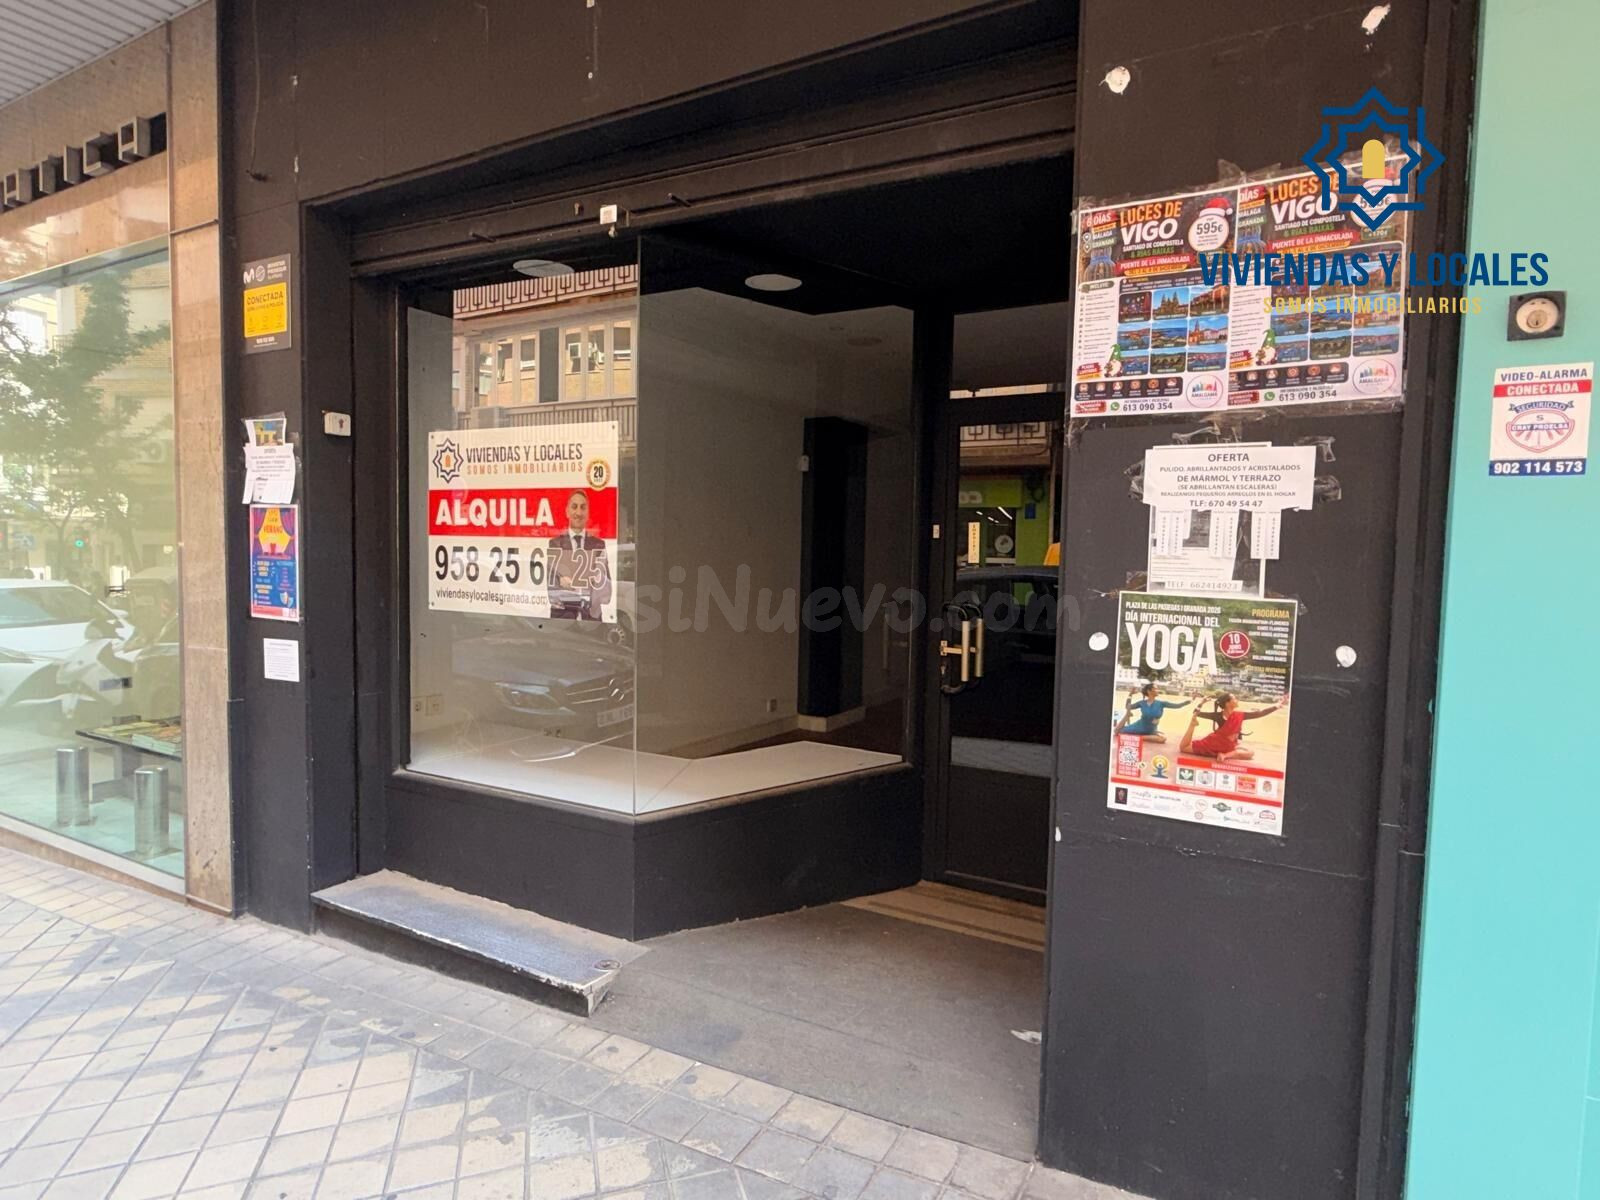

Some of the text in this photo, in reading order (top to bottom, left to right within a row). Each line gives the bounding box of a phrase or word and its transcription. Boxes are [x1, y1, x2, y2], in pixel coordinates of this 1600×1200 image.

[2, 113, 152, 208] ATICA
[1269, 177, 1319, 204] LUCES
[1120, 201, 1182, 226] LUCES DE
[1271, 192, 1338, 224] VIGO
[1196, 221, 1223, 235] 595€
[1275, 221, 1300, 231] SANTIAGO
[1309, 214, 1346, 226] COMPOSTELA
[1120, 218, 1178, 246] VIGO
[1122, 243, 1145, 252] SANTIAGO
[1153, 239, 1184, 247] COMPOSTELA
[1272, 239, 1295, 249] PUENTE
[1314, 232, 1353, 243] INMACULADA
[1120, 261, 1140, 269] PUENTE
[1157, 256, 1190, 266] INMACULADA
[247, 291, 284, 305] CONECTADA
[1500, 368, 1588, 382] VIDEO-ALARMA
[1279, 389, 1337, 402] 613 090 354
[1507, 383, 1580, 396] CONECTADA
[1123, 401, 1173, 412] 613 090 354
[1516, 401, 1566, 411] SEGURIDAD
[466, 443, 583, 463] VIVIENDAS Y LOCALES
[1207, 453, 1250, 462] OFERTA
[466, 461, 583, 475] SOMOS INMOBILIARIOS
[594, 466, 604, 479] 20
[1494, 461, 1583, 474] 902 114 573
[435, 498, 555, 528] ALQUILA
[435, 545, 608, 590] 958 25 67 25
[435, 588, 549, 606] viviendasylocalesgranada.com
[1125, 610, 1138, 621] DÍA
[1140, 612, 1202, 626] INTERNACIONAL
[1204, 616, 1220, 627] DEL
[1251, 608, 1290, 618] PROGRAMA
[1228, 633, 1240, 644] 10
[1125, 622, 1218, 675] YOGA
